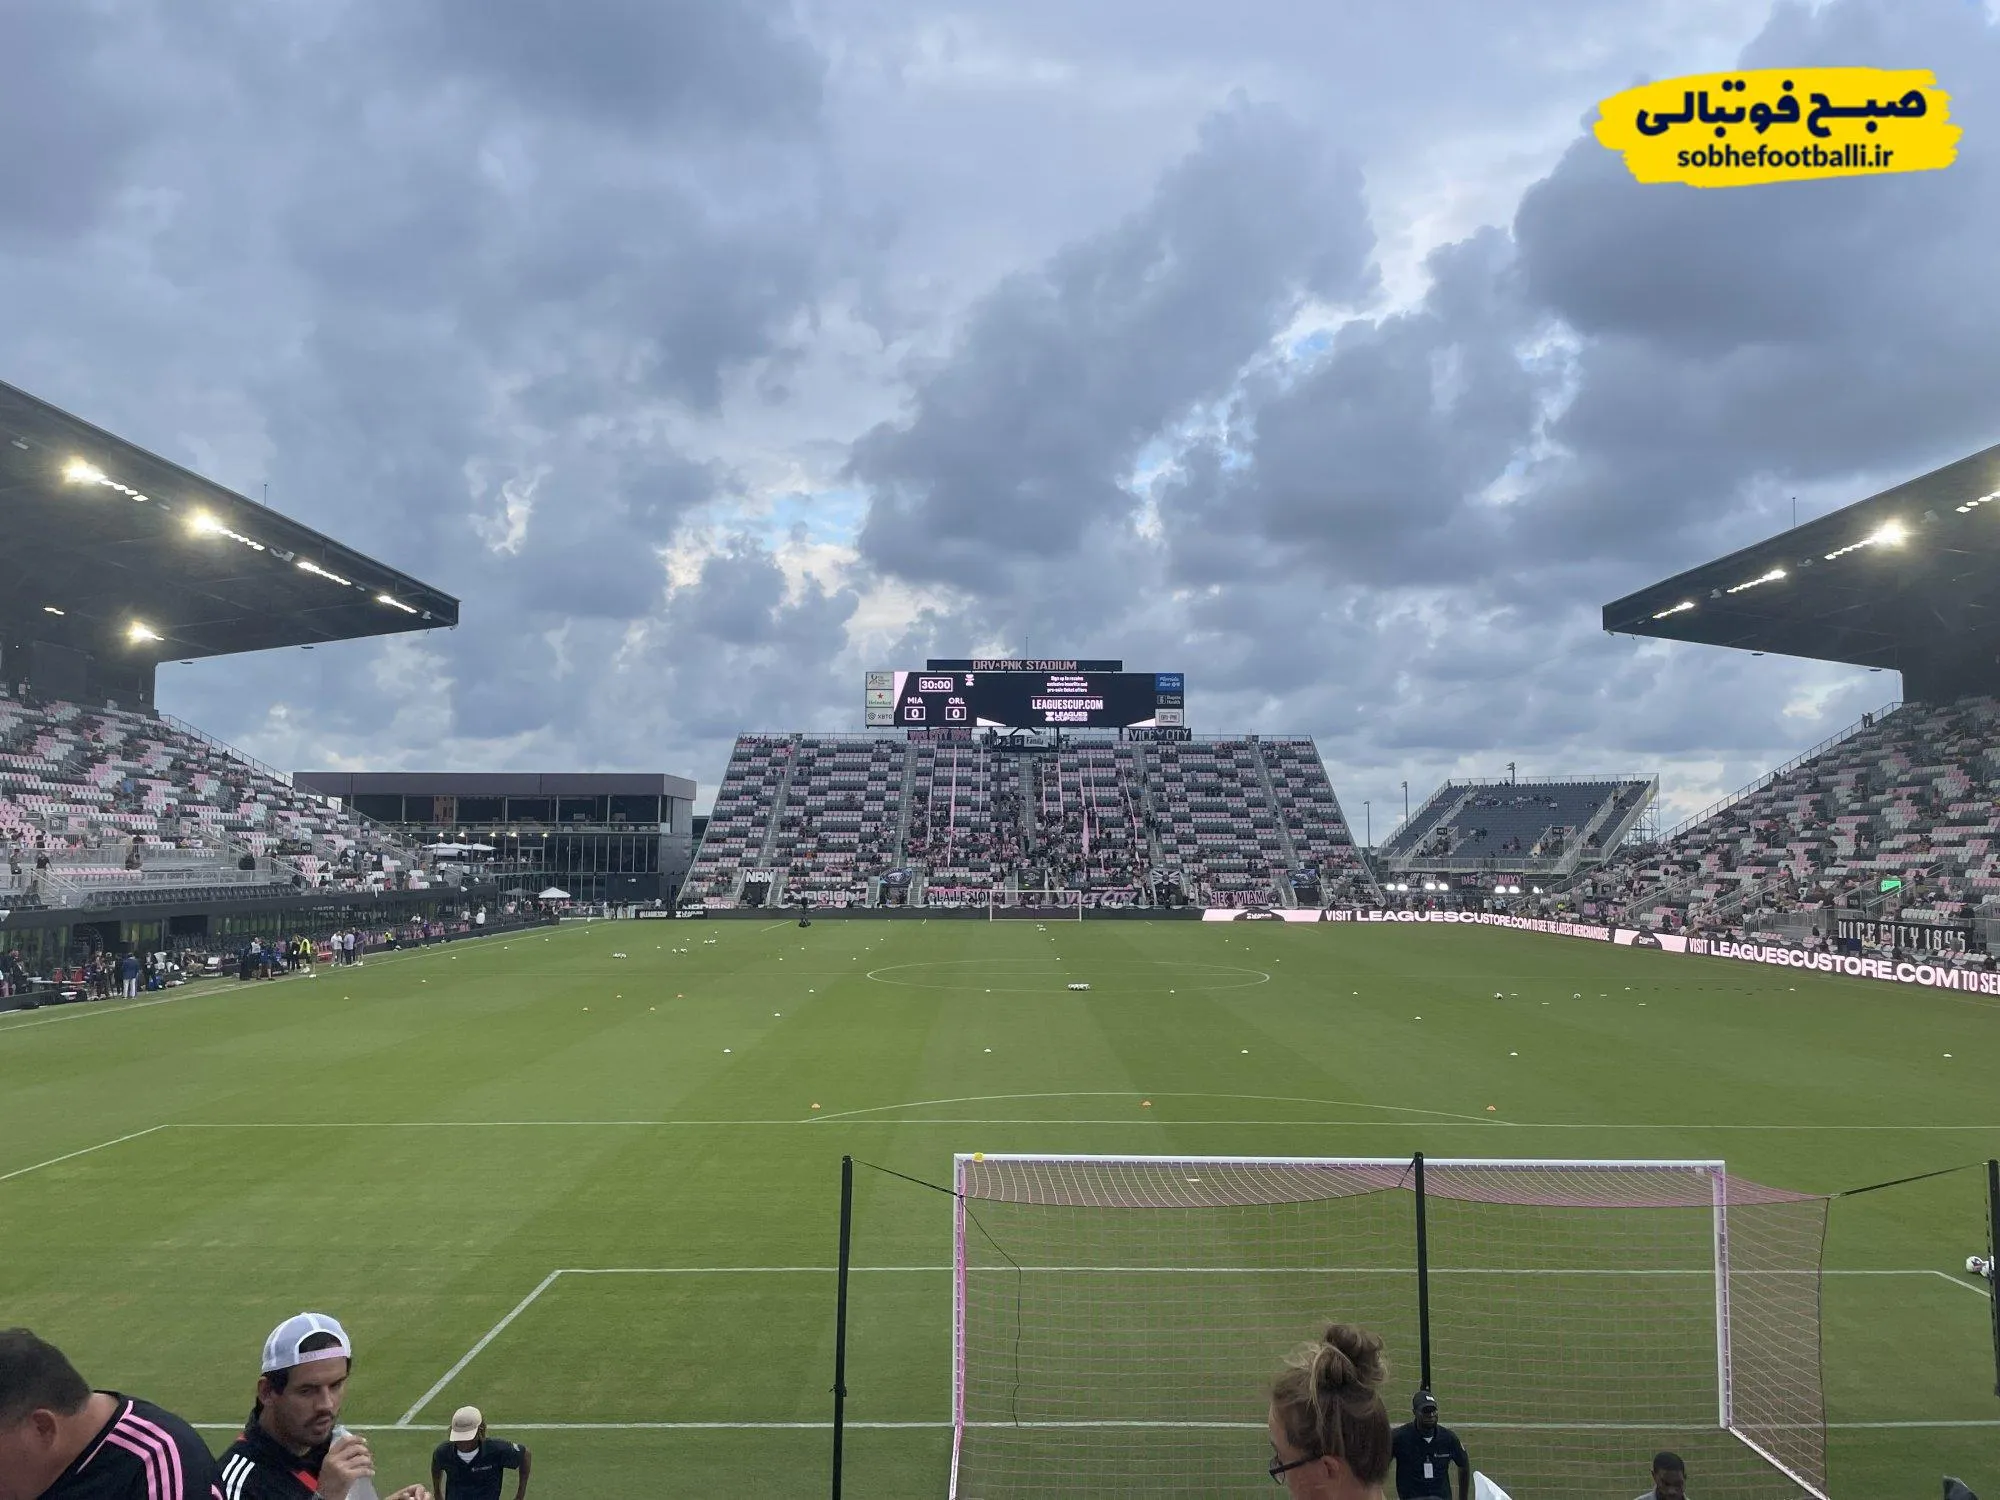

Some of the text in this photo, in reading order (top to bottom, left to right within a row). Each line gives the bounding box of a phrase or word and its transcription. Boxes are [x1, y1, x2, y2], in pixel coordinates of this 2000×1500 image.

[1026, 660, 1077, 671] STADIUM
[921, 680, 951, 690] 30:00
[948, 697, 965, 705] ORL
[1031, 699, 1104, 710] LEAGUESCUP.COM
[911, 708, 920, 719] 0
[952, 708, 961, 719] 0
[1166, 729, 1189, 740] CITY
[745, 871, 775, 883] NRN
[1325, 910, 1352, 922] VISIT
[1356, 910, 1532, 929] LEAGUESCUSTORE.COM
[1688, 937, 2000, 996] VISIT LEAGUESCUSTORE.COM TO SE
